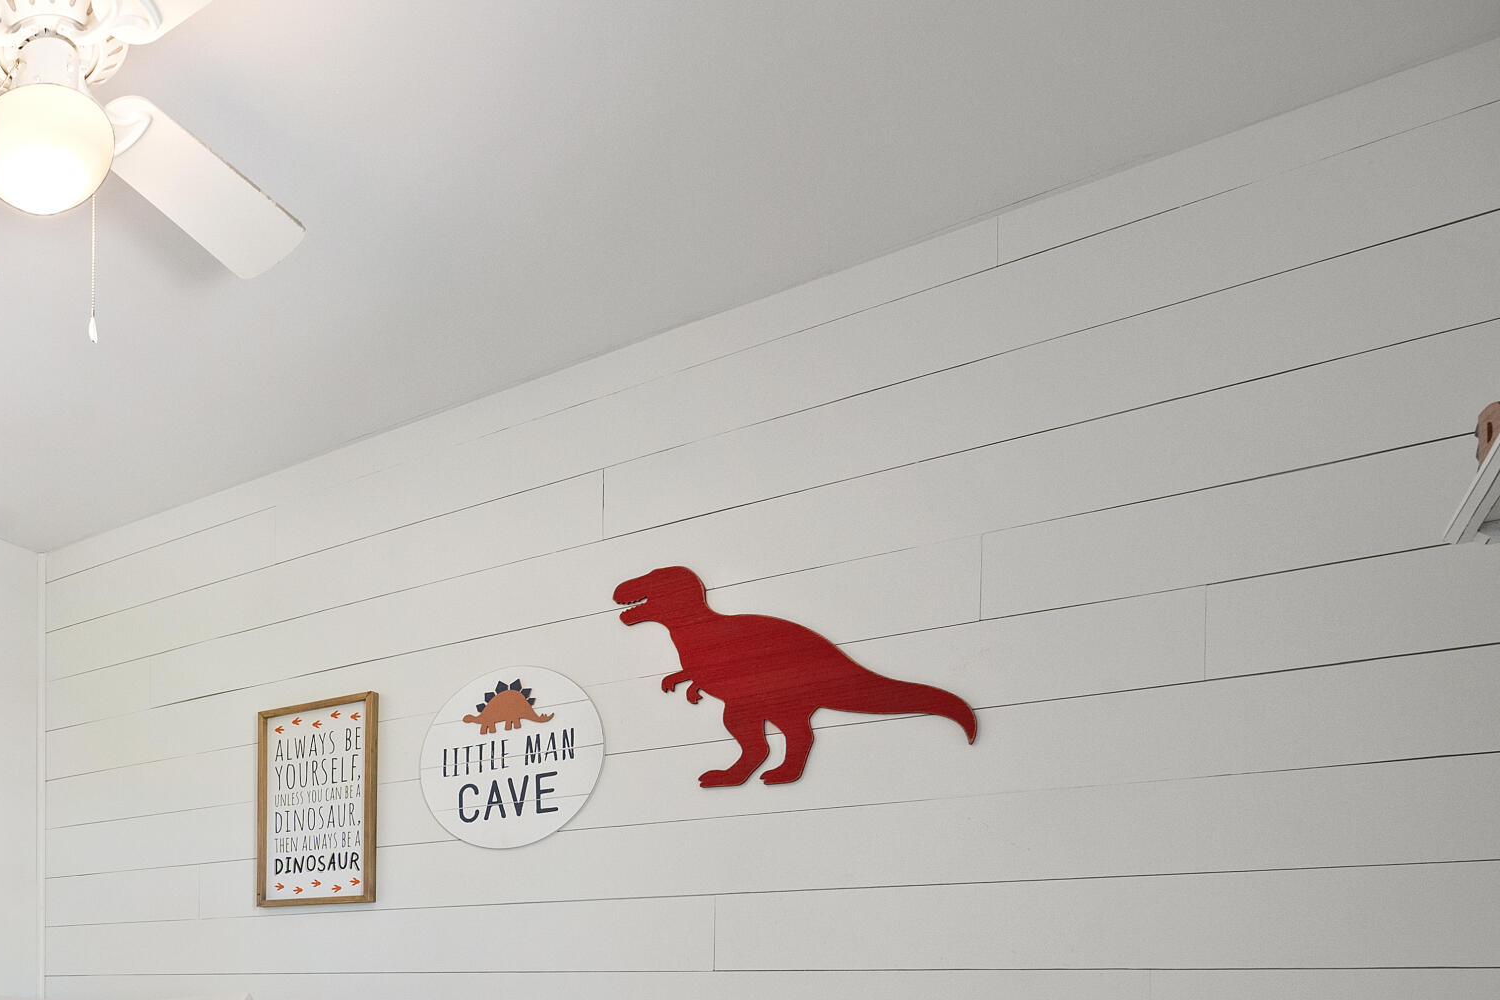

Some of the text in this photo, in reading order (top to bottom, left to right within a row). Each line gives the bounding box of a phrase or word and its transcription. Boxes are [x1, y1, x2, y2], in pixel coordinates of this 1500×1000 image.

[275, 727, 362, 762] ALWAYS BE
[443, 728, 575, 778] LITTLE MAN
[275, 754, 361, 791] YOURSELF,
[274, 784, 361, 807] UNLESS YOU CAN BE A
[458, 771, 559, 823] CAVE
[275, 803, 361, 834] DINOSAUR,
[275, 830, 361, 853] THEN ALWAYS BE A
[275, 852, 360, 875] DINOSAUR
